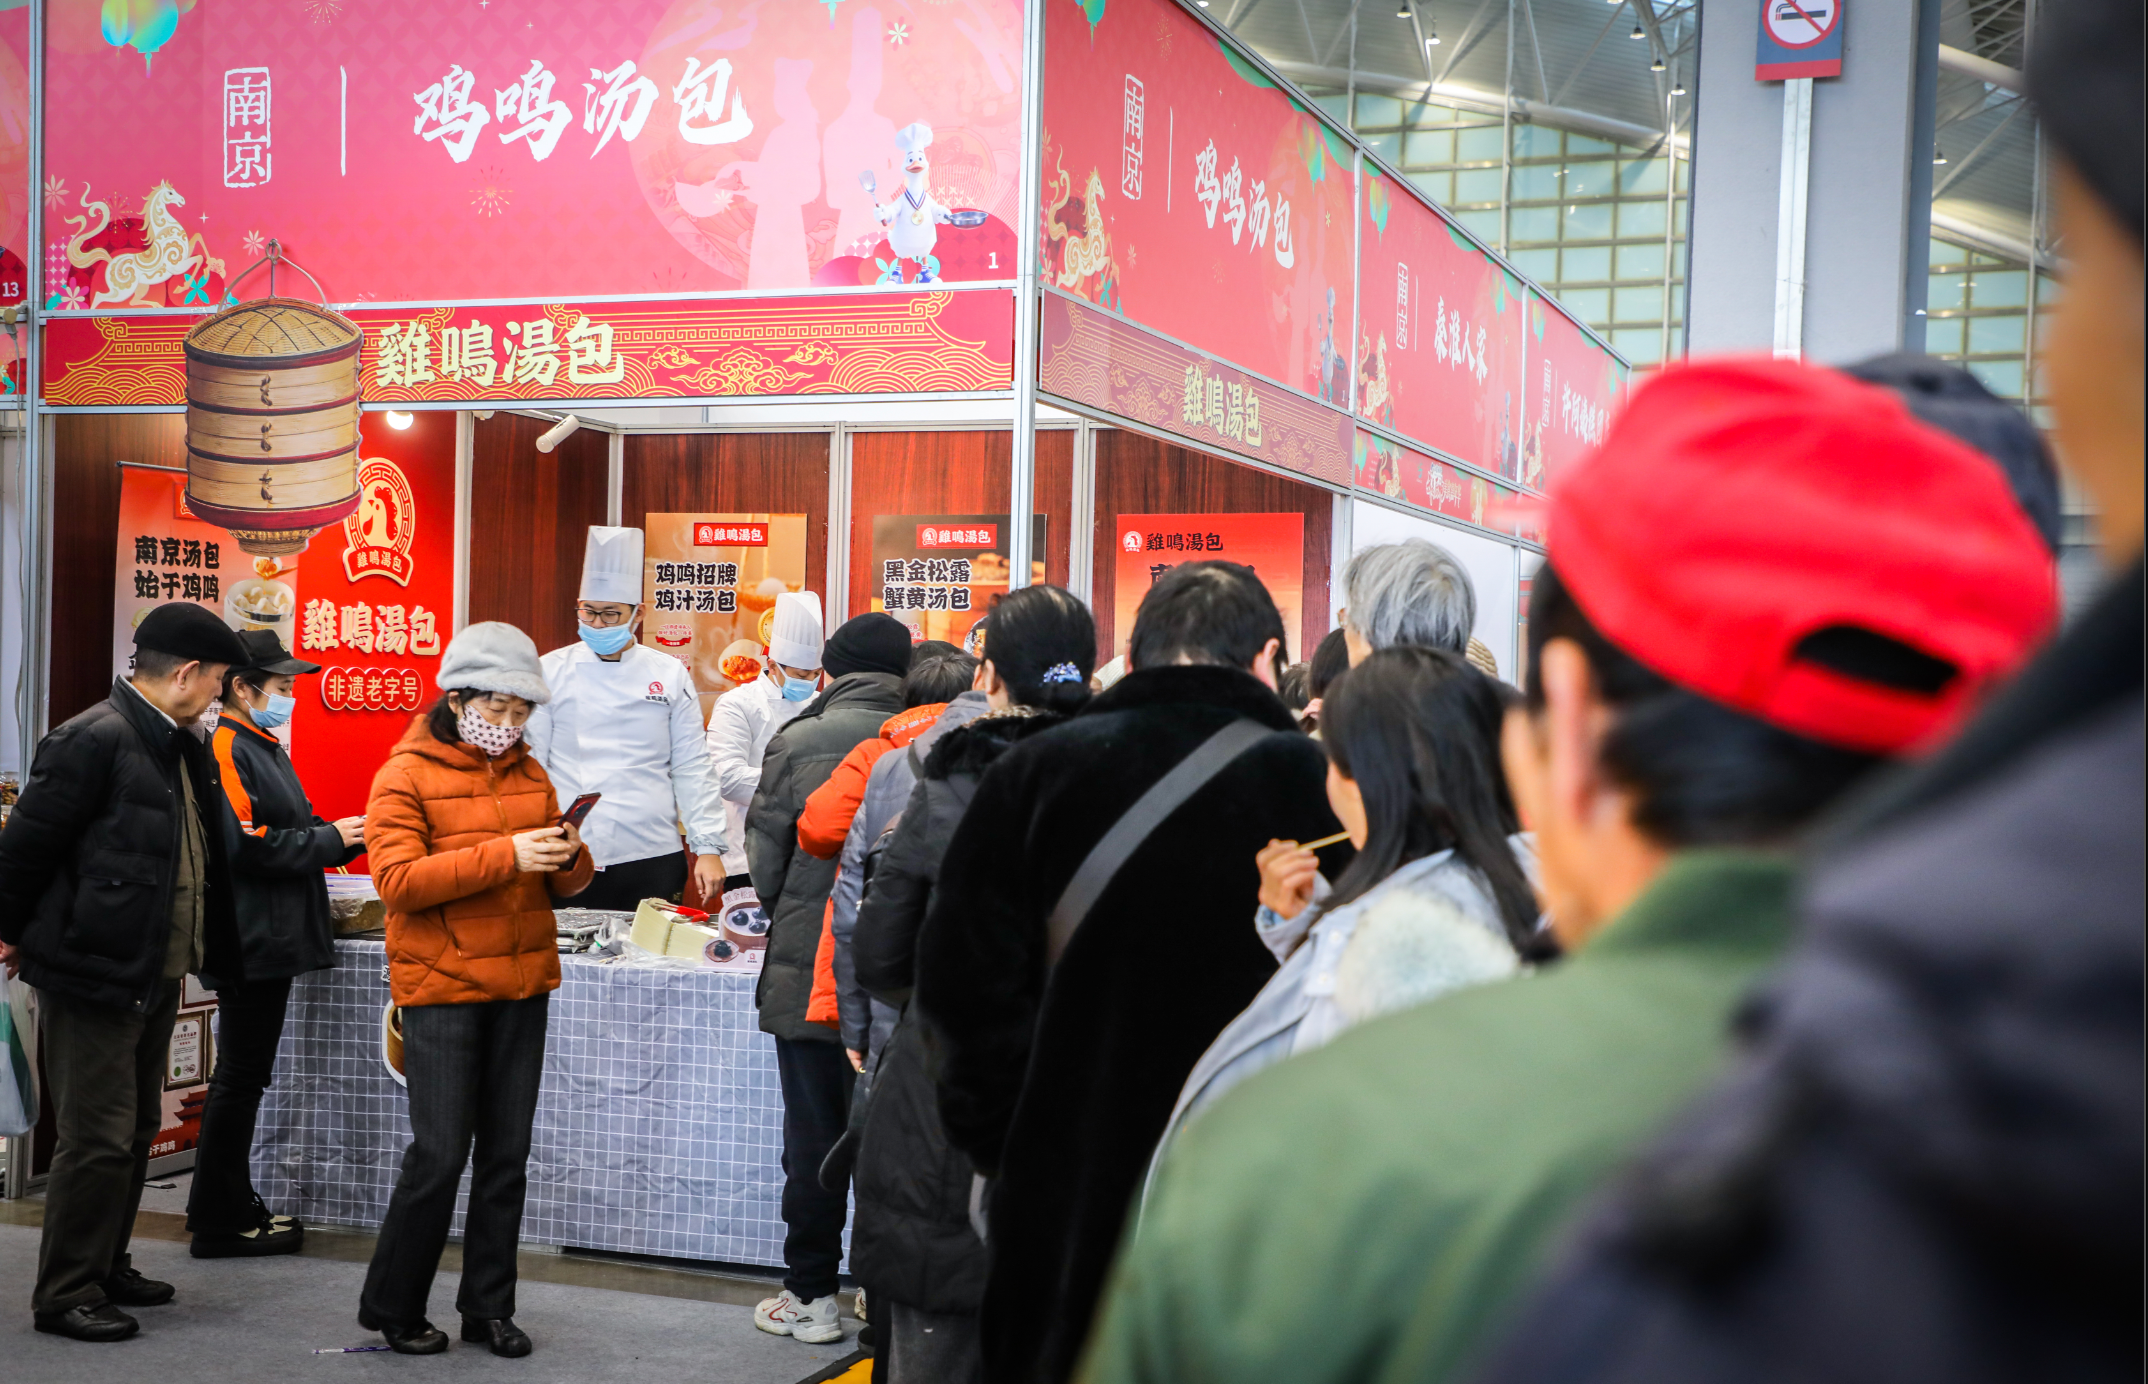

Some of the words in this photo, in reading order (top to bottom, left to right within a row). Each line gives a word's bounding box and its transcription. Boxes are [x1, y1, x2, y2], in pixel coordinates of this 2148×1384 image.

[413, 57, 753, 164] 鸡鸣汤包
[228, 76, 267, 180] 南京
[1122, 86, 1143, 193] 南京
[1195, 138, 1295, 269] 鸡鸣汤包
[989, 252, 999, 269] 1
[2, 281, 20, 297] 13
[375, 315, 625, 388] 雞鳴湯包
[1433, 295, 1488, 386] 秦淮人家
[1183, 363, 1262, 447] 雞鳴湯包
[713, 528, 763, 542] 雞鳴湯包
[938, 530, 991, 544] 雞鳴湯包
[1146, 532, 1224, 551] 雞鳴湯包
[134, 535, 220, 570] 南京汤包
[356, 549, 403, 574] 雞鳴湯包
[133, 569, 220, 603] 始于鸡鸣
[656, 563, 737, 586] 鸡鸣招牌
[885, 560, 970, 583] 黑金松露
[655, 589, 735, 613] 鸡汁汤包
[884, 587, 970, 610] 蟹黄汤包
[301, 597, 441, 657] 雞鳴湯包
[328, 674, 418, 703] 非遗老字号
